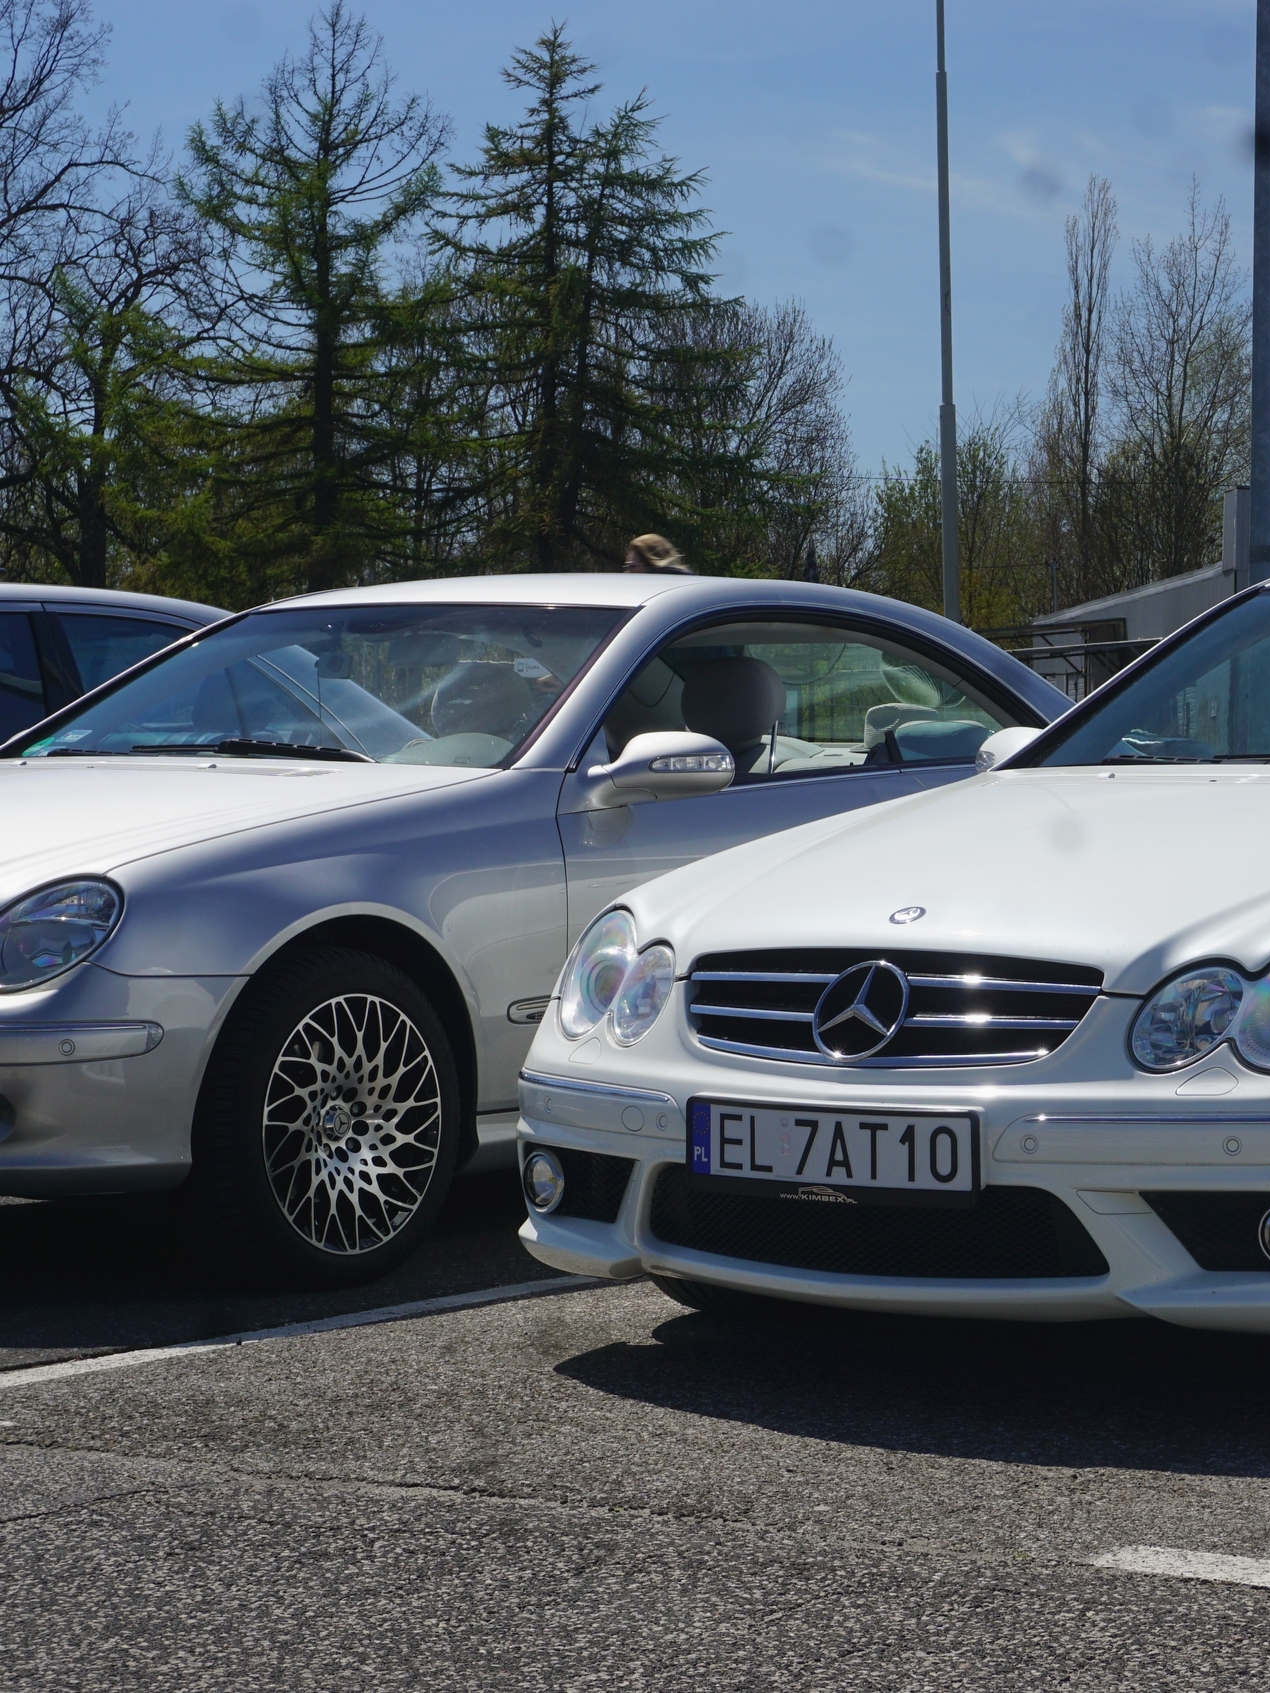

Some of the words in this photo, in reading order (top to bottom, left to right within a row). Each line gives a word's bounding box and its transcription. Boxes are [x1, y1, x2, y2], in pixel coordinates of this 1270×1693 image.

[693, 1145, 708, 1162] PL
[719, 1112, 773, 1173] EL
[794, 1118, 958, 1184] 7AT10
